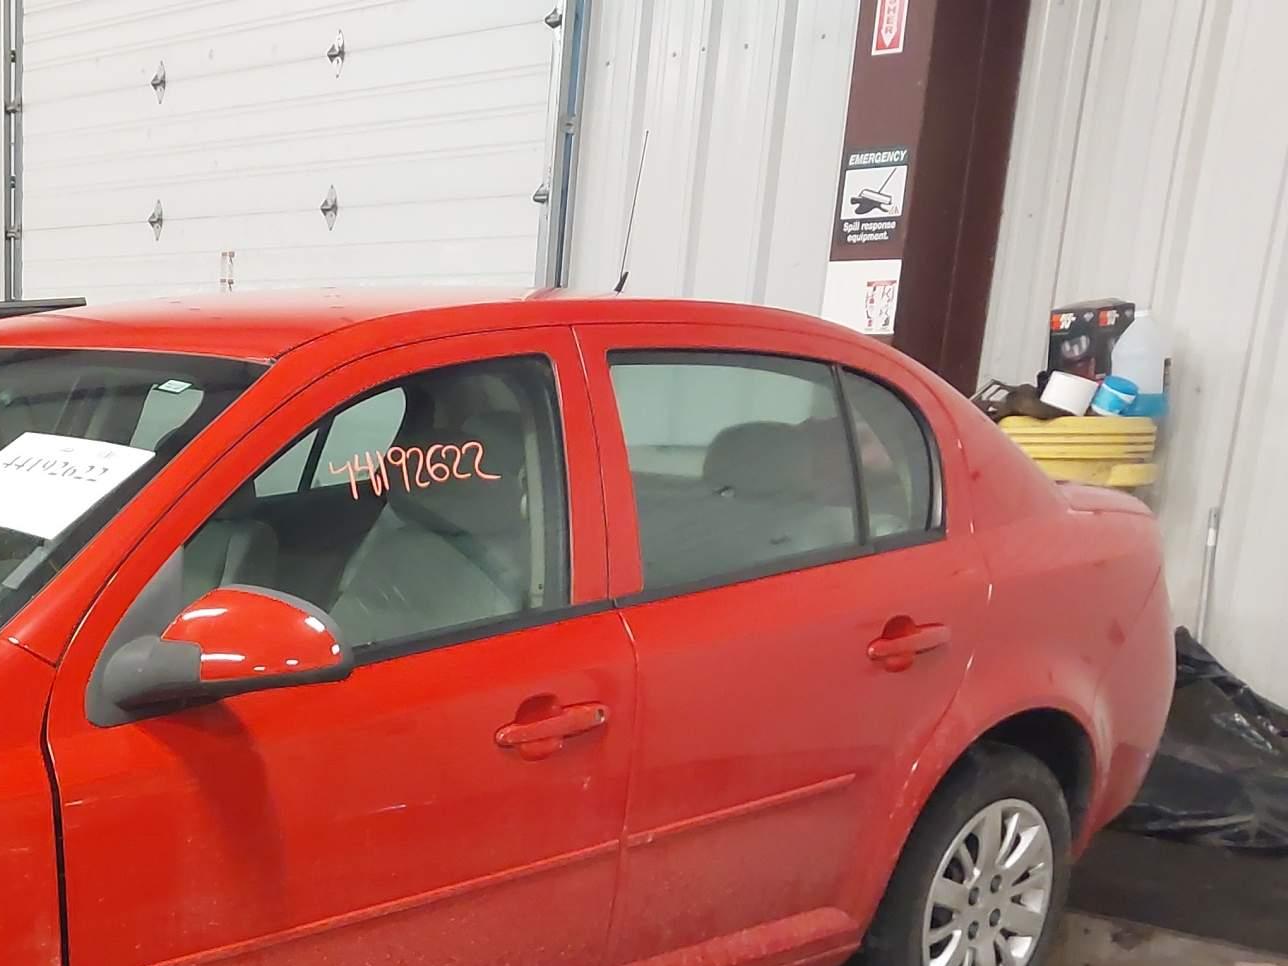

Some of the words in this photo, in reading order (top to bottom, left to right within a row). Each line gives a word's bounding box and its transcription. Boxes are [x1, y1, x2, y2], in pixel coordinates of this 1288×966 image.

[849, 150, 907, 166] EMERGENCY
[843, 221, 861, 233] Spill
[861, 221, 897, 232] response
[847, 231, 889, 243] equipment.
[2, 456, 109, 482] 44192622
[329, 441, 502, 500] 44192622
